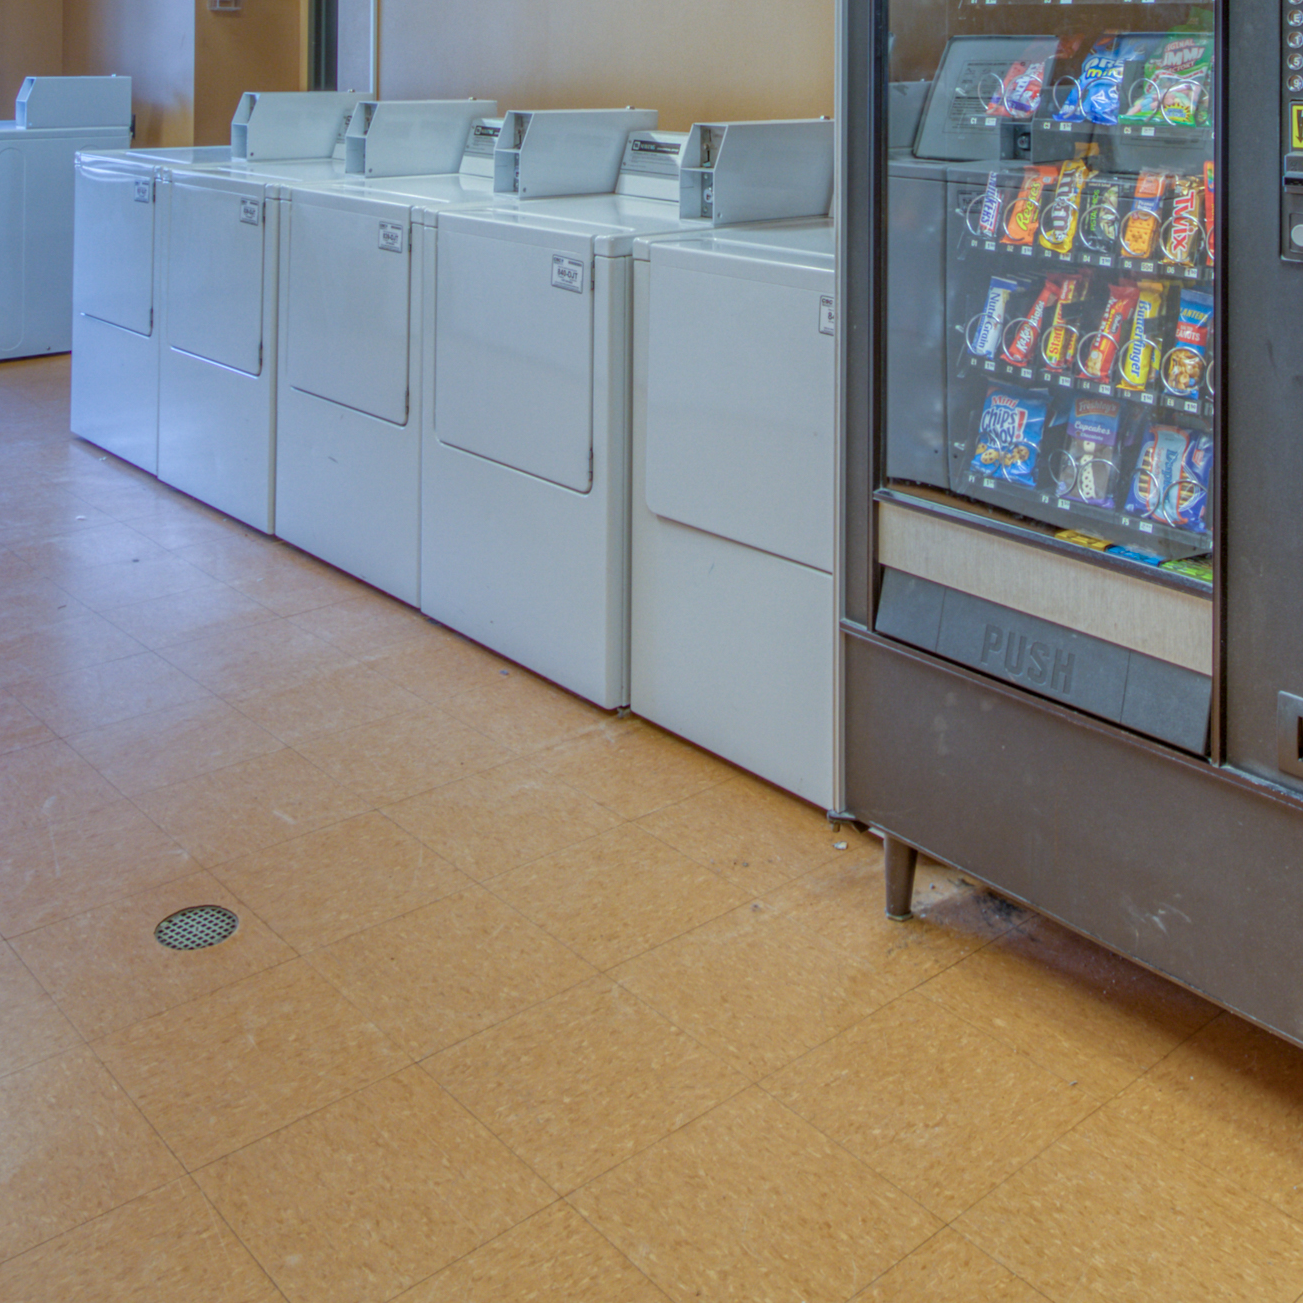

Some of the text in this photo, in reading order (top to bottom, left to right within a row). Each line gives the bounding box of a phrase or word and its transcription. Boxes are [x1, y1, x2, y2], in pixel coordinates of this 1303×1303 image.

[1085, 56, 1125, 70] ORE
[980, 171, 998, 229] SNICKERS
[1016, 182, 1041, 231] Reese's
[1089, 189, 1100, 231] PISTAHIOS
[976, 320, 994, 350] Grain
[1015, 325, 1032, 353] KitKat
[1130, 300, 1152, 377] Butterfinger
[1175, 329, 1201, 341] EANUTS
[991, 395, 1019, 408] Mini
[1078, 400, 1117, 414] Freshley's
[1074, 420, 1111, 436] Cupcakes
[1080, 432, 1104, 441] Chocolate
[980, 622, 1076, 695] PUSH
